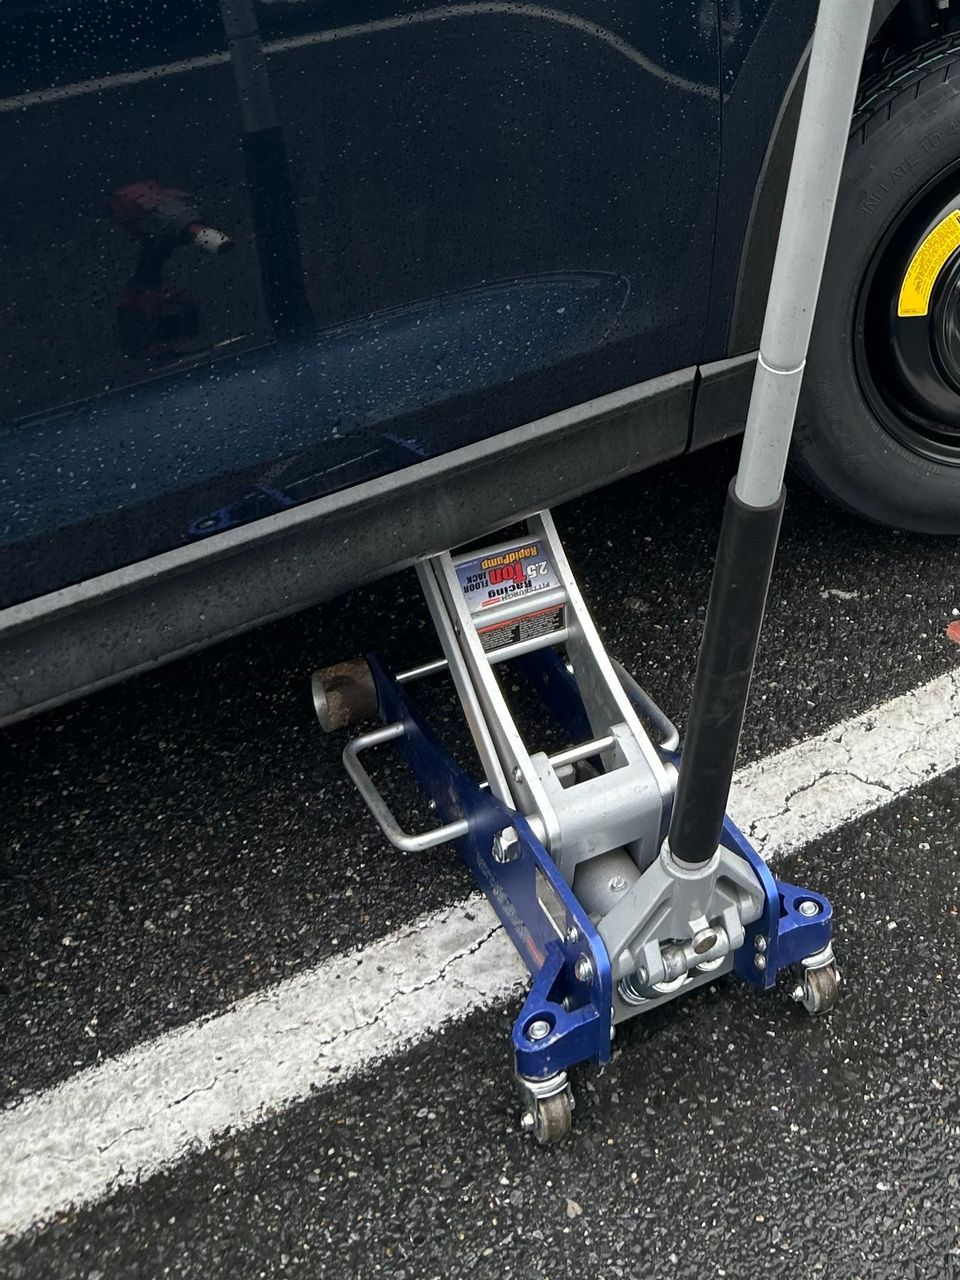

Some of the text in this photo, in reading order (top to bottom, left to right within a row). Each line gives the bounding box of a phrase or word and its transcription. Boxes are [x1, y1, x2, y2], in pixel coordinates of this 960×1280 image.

[482, 546, 537, 569] RapidPump
[467, 570, 487, 584] JACK
[489, 561, 548, 585] 2.5 Ton
[464, 579, 488, 594] FLOOR
[488, 580, 532, 598] Racing
[501, 582, 550, 601] PITTSBURGH
